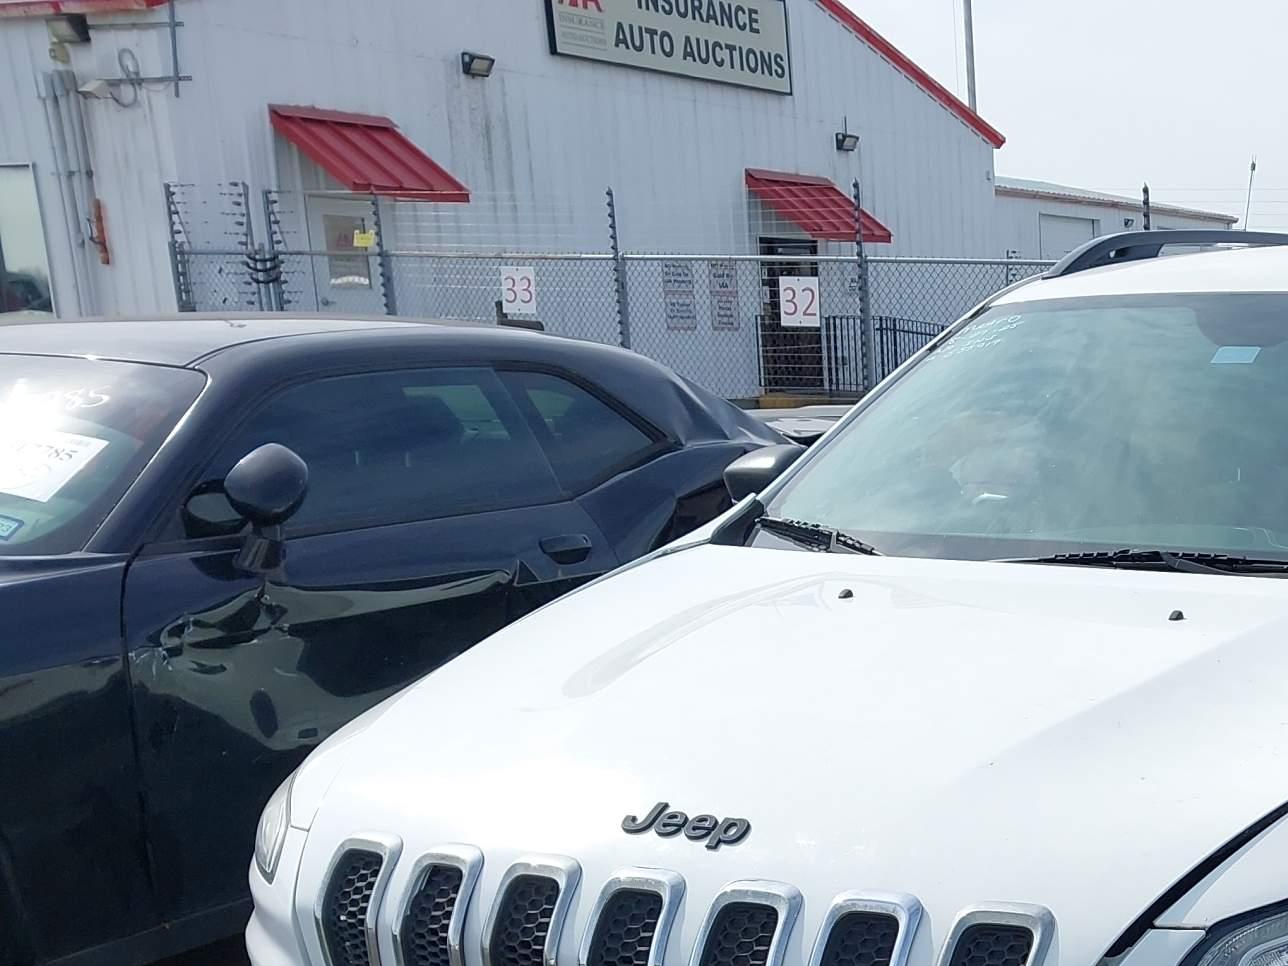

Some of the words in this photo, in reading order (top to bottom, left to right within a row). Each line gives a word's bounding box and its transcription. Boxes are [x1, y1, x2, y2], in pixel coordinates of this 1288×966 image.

[614, 21, 674, 58] AUTO
[682, 35, 786, 78] AUCTIONS
[504, 275, 533, 304] 33
[783, 286, 817, 316] 32
[621, 802, 752, 850] Jeep
